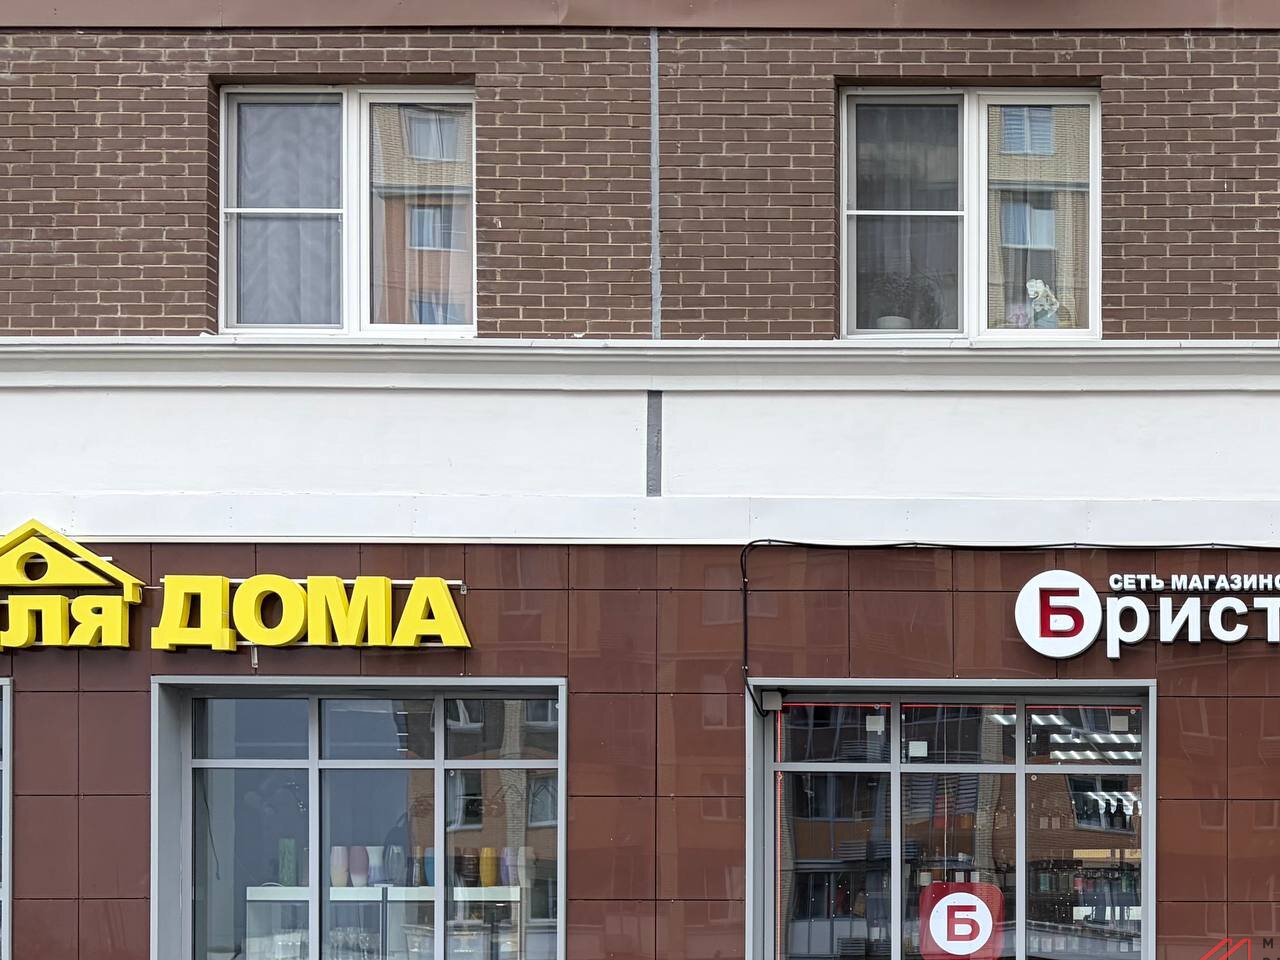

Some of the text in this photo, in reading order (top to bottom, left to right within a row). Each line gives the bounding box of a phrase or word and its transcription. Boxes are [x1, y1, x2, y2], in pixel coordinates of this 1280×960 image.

[1108, 573, 1165, 591] СЕТЬ
[0, 573, 471, 652] ЛЯ ДОМА
[946, 904, 981, 942] Б
